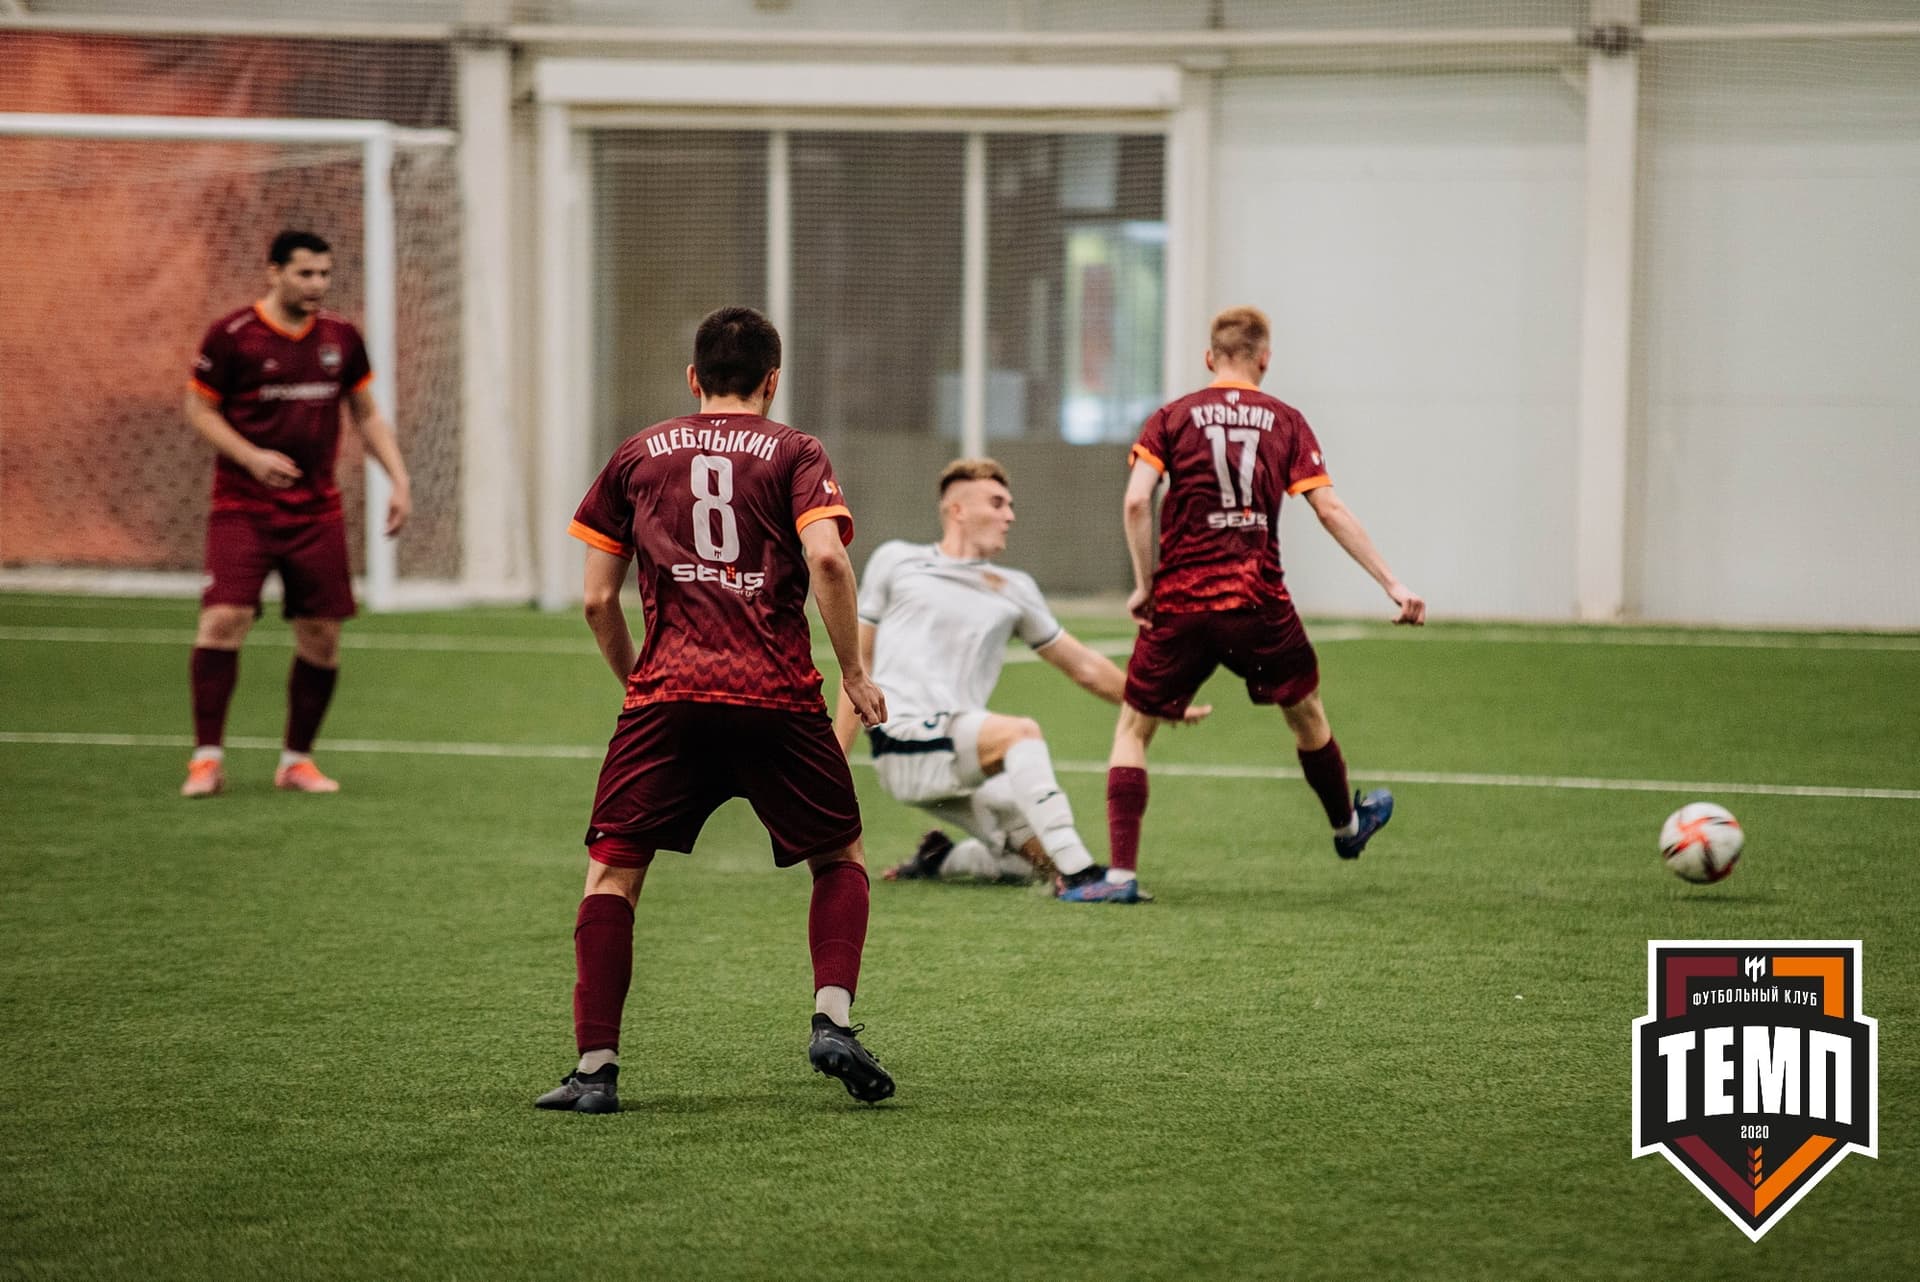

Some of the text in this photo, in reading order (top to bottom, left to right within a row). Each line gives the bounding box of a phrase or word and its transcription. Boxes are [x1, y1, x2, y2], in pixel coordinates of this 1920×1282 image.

[646, 427, 780, 461] ЩЕБЛЫКИН
[1190, 403, 1275, 432] КУЗЬКИН
[1204, 424, 1260, 508] 17
[690, 454, 740, 563] 8
